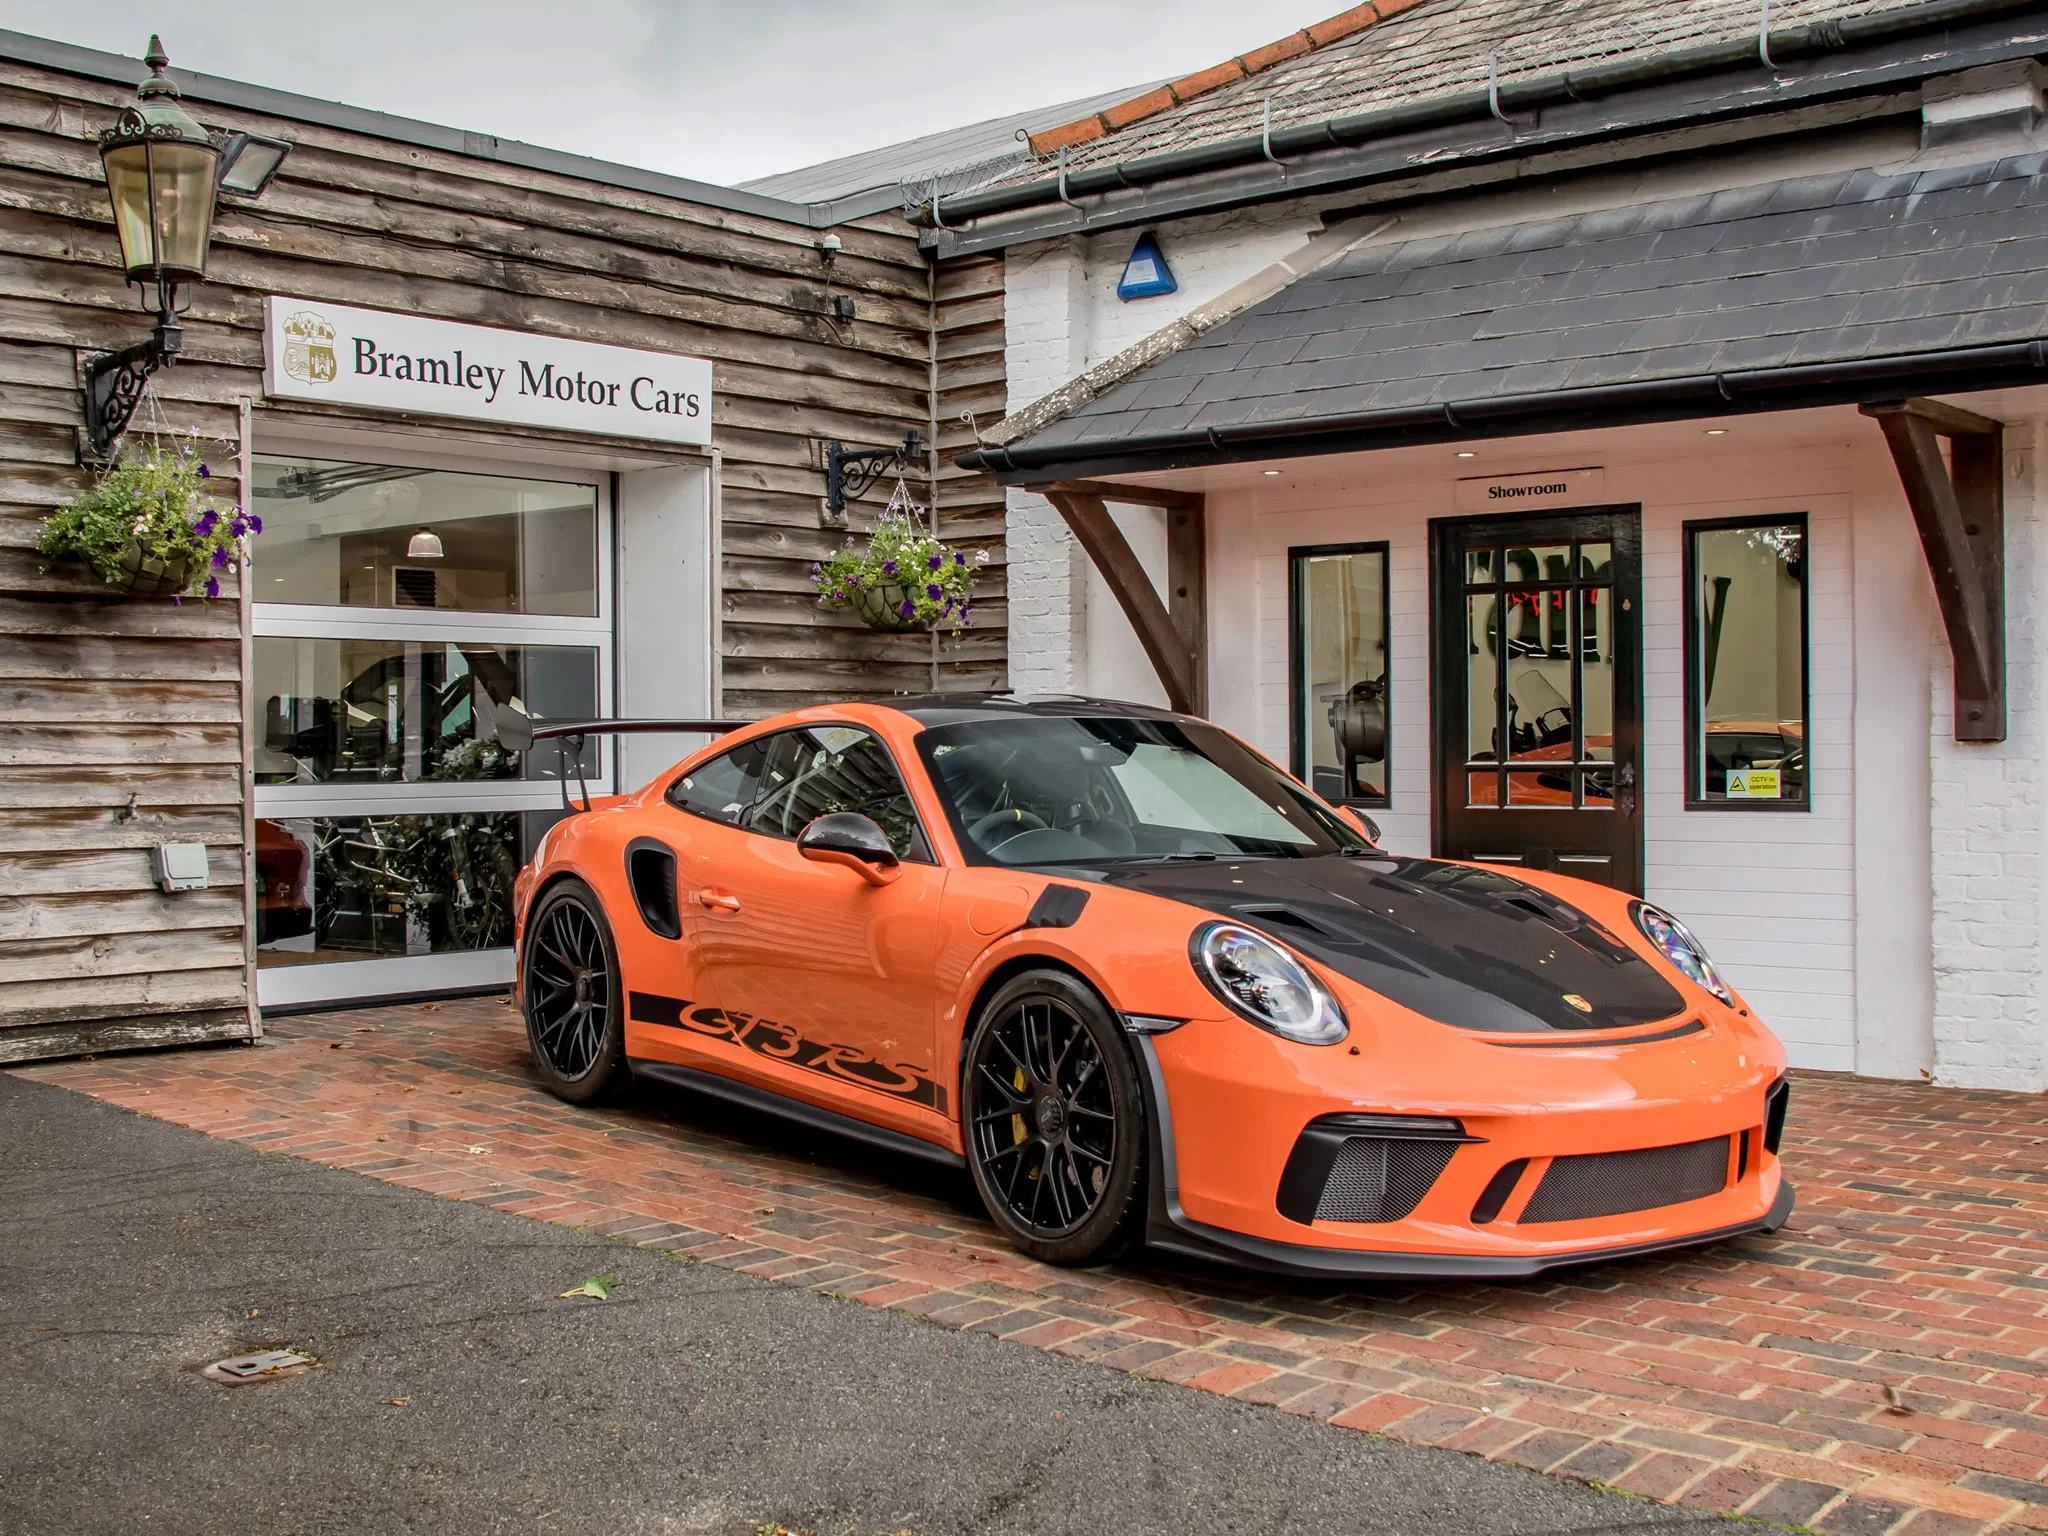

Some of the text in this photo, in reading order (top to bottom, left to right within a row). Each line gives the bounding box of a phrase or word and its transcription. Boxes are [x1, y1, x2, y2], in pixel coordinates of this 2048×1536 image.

[352, 337, 700, 417] Bramley Motor Cars
[1488, 483, 1567, 499] Showroom
[679, 1002, 929, 1092] GT3 RS
